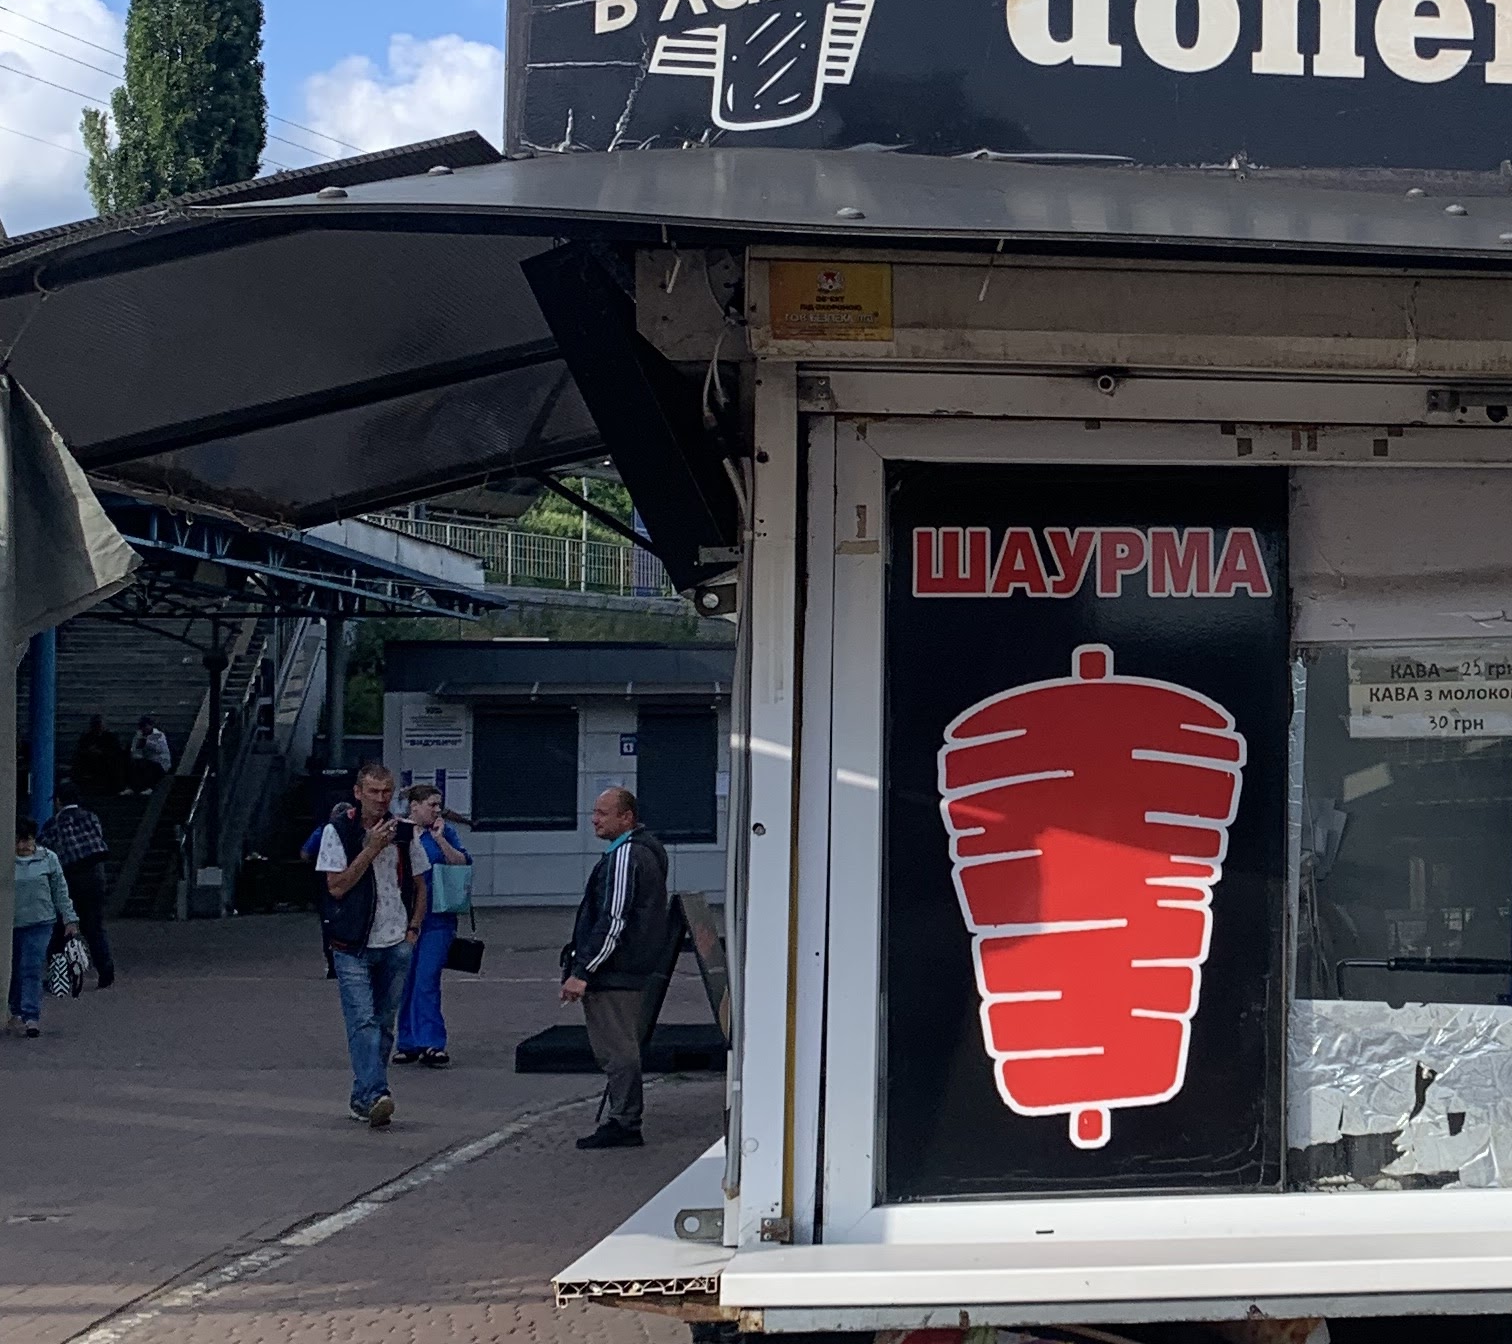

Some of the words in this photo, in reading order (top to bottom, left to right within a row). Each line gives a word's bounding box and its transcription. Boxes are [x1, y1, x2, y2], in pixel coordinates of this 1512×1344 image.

[912, 526, 1273, 598] ШАУРМА
[1390, 663, 1440, 680] КАВА
[1461, 658, 1482, 677] 25
[1369, 686, 1419, 703] КАВА
[1428, 716, 1449, 731] 30
[1453, 718, 1484, 733] грн
